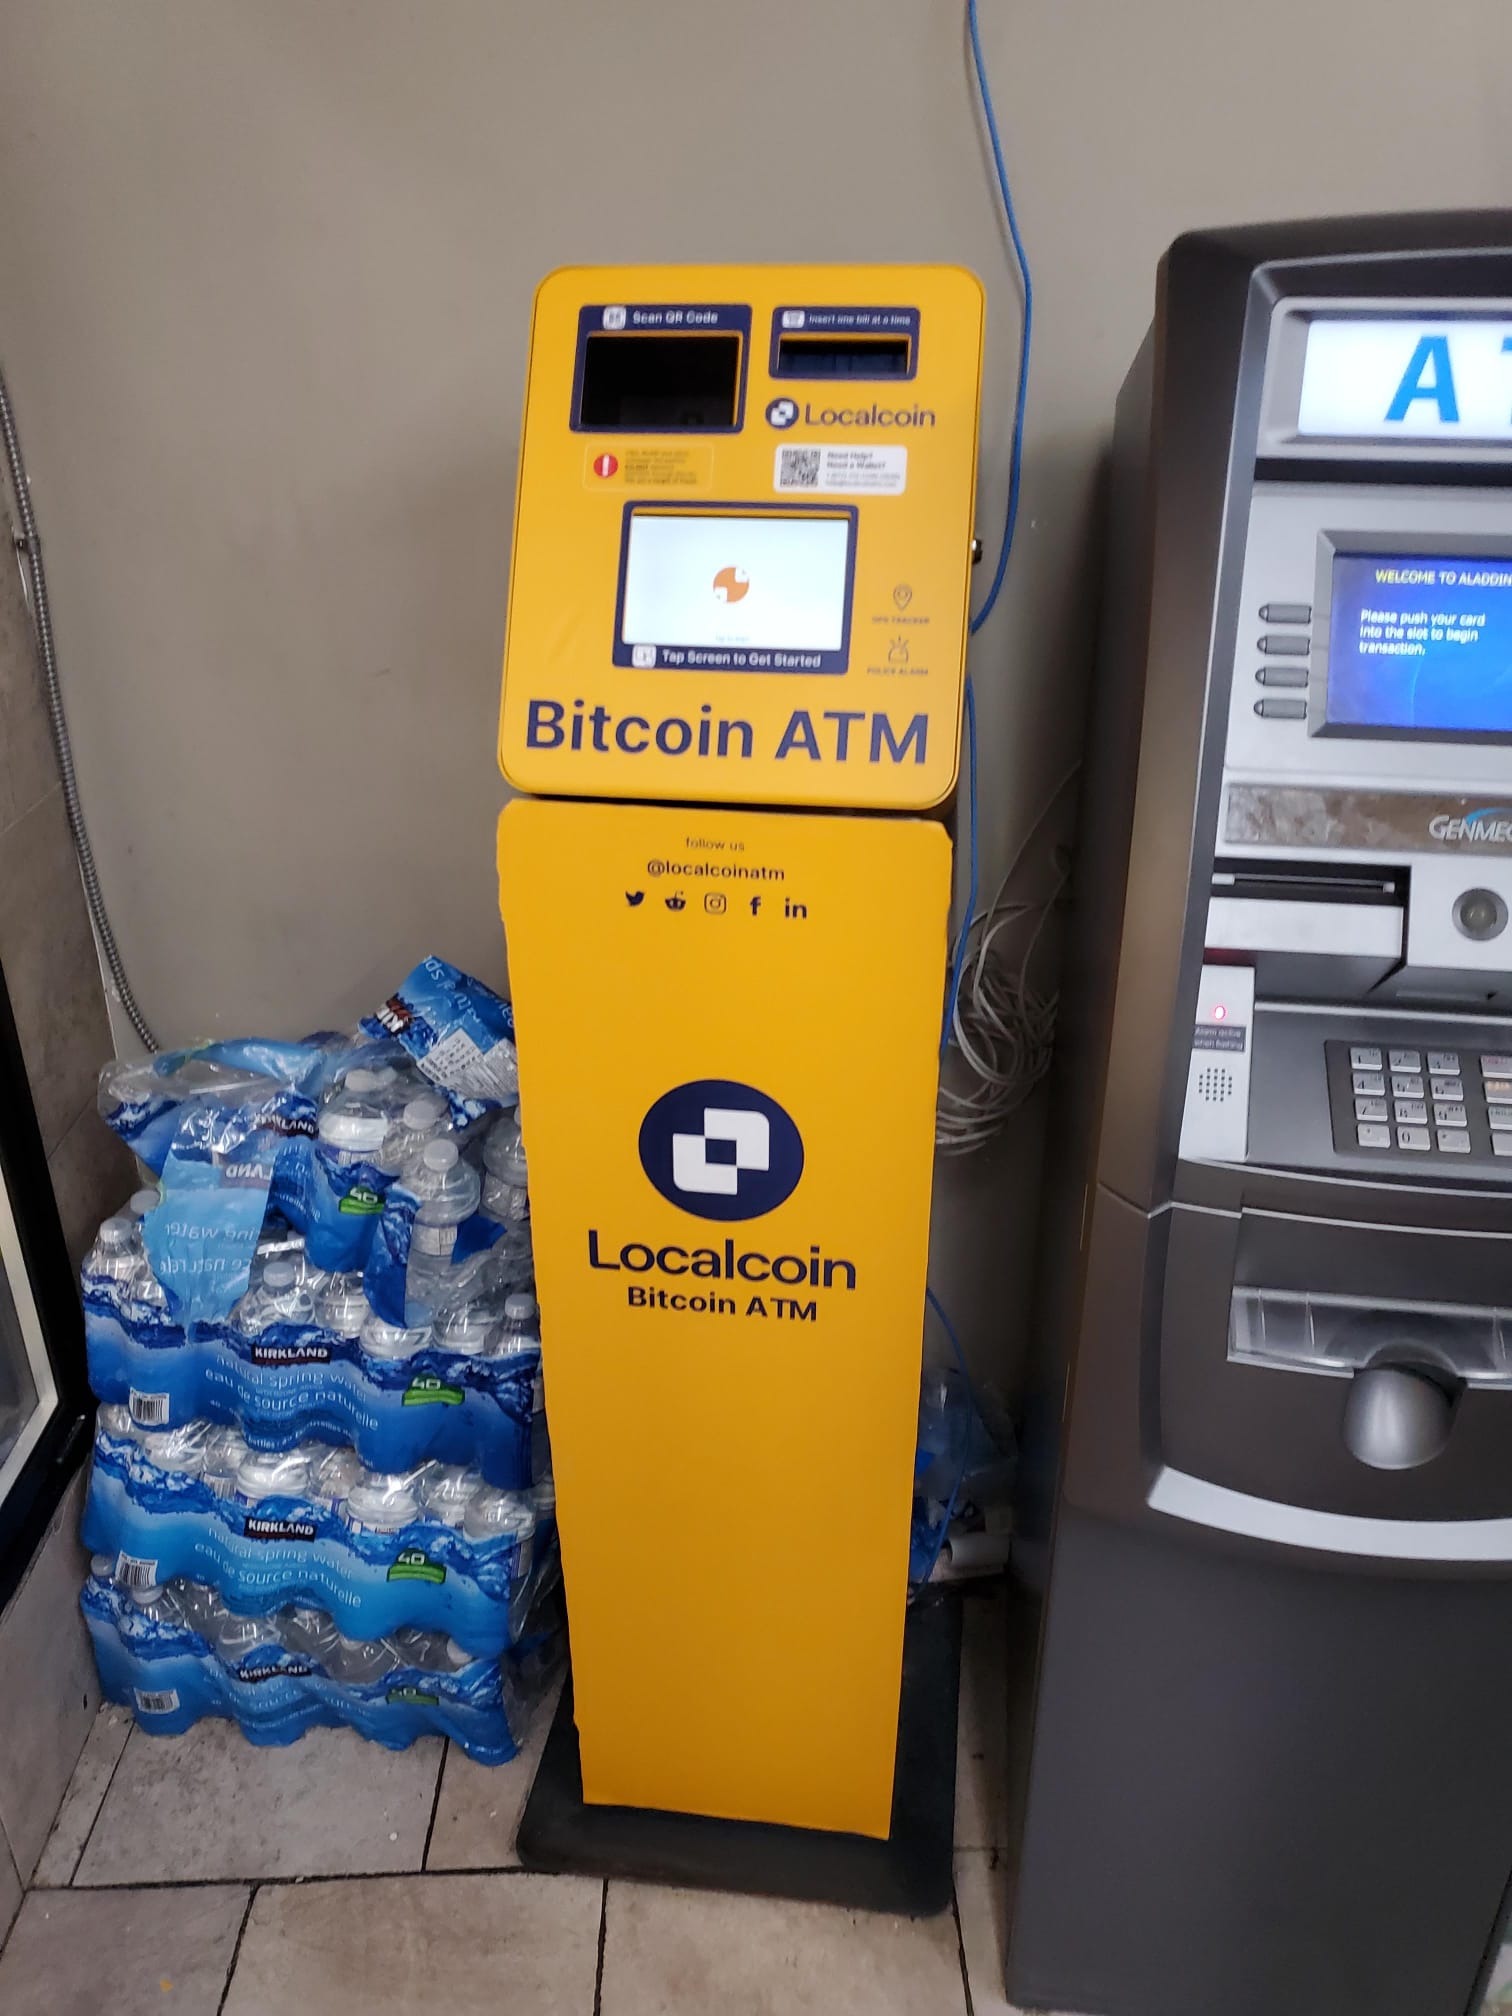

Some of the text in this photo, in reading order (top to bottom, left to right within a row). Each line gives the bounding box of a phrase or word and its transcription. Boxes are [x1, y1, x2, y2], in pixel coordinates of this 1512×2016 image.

[633, 310, 719, 325] Scan QR Code
[804, 404, 936, 428] Localcoin
[1375, 569, 1436, 585] WELCOME
[1439, 570, 1456, 585] TO
[1360, 607, 1486, 627] Please push your card
[1385, 625, 1404, 640] the
[1406, 626, 1429, 641] slot
[1431, 627, 1444, 641] to
[1446, 627, 1479, 644] begin
[662, 649, 822, 668] Tap Screen to Get Started
[526, 698, 929, 764] Bitcoin ATM
[686, 836, 745, 851] follow us
[647, 859, 785, 881] @localcoinatm
[588, 1229, 857, 1290] Localcoin
[627, 1286, 817, 1322] Bitcoin ATM
[254, 1346, 329, 1359] KIRKLAND
[269, 1371, 324, 1390] spring
[411, 1376, 441, 1390] 40
[205, 1368, 234, 1388] eau
[237, 1384, 250, 1401] de
[254, 1391, 310, 1411] source
[315, 1391, 379, 1431] naturelle
[248, 1519, 315, 1536] KIRKLAND
[397, 1552, 425, 1566] 40
[194, 1543, 221, 1564] eau
[239, 1569, 293, 1585] source
[298, 1569, 362, 1609] naturelle
